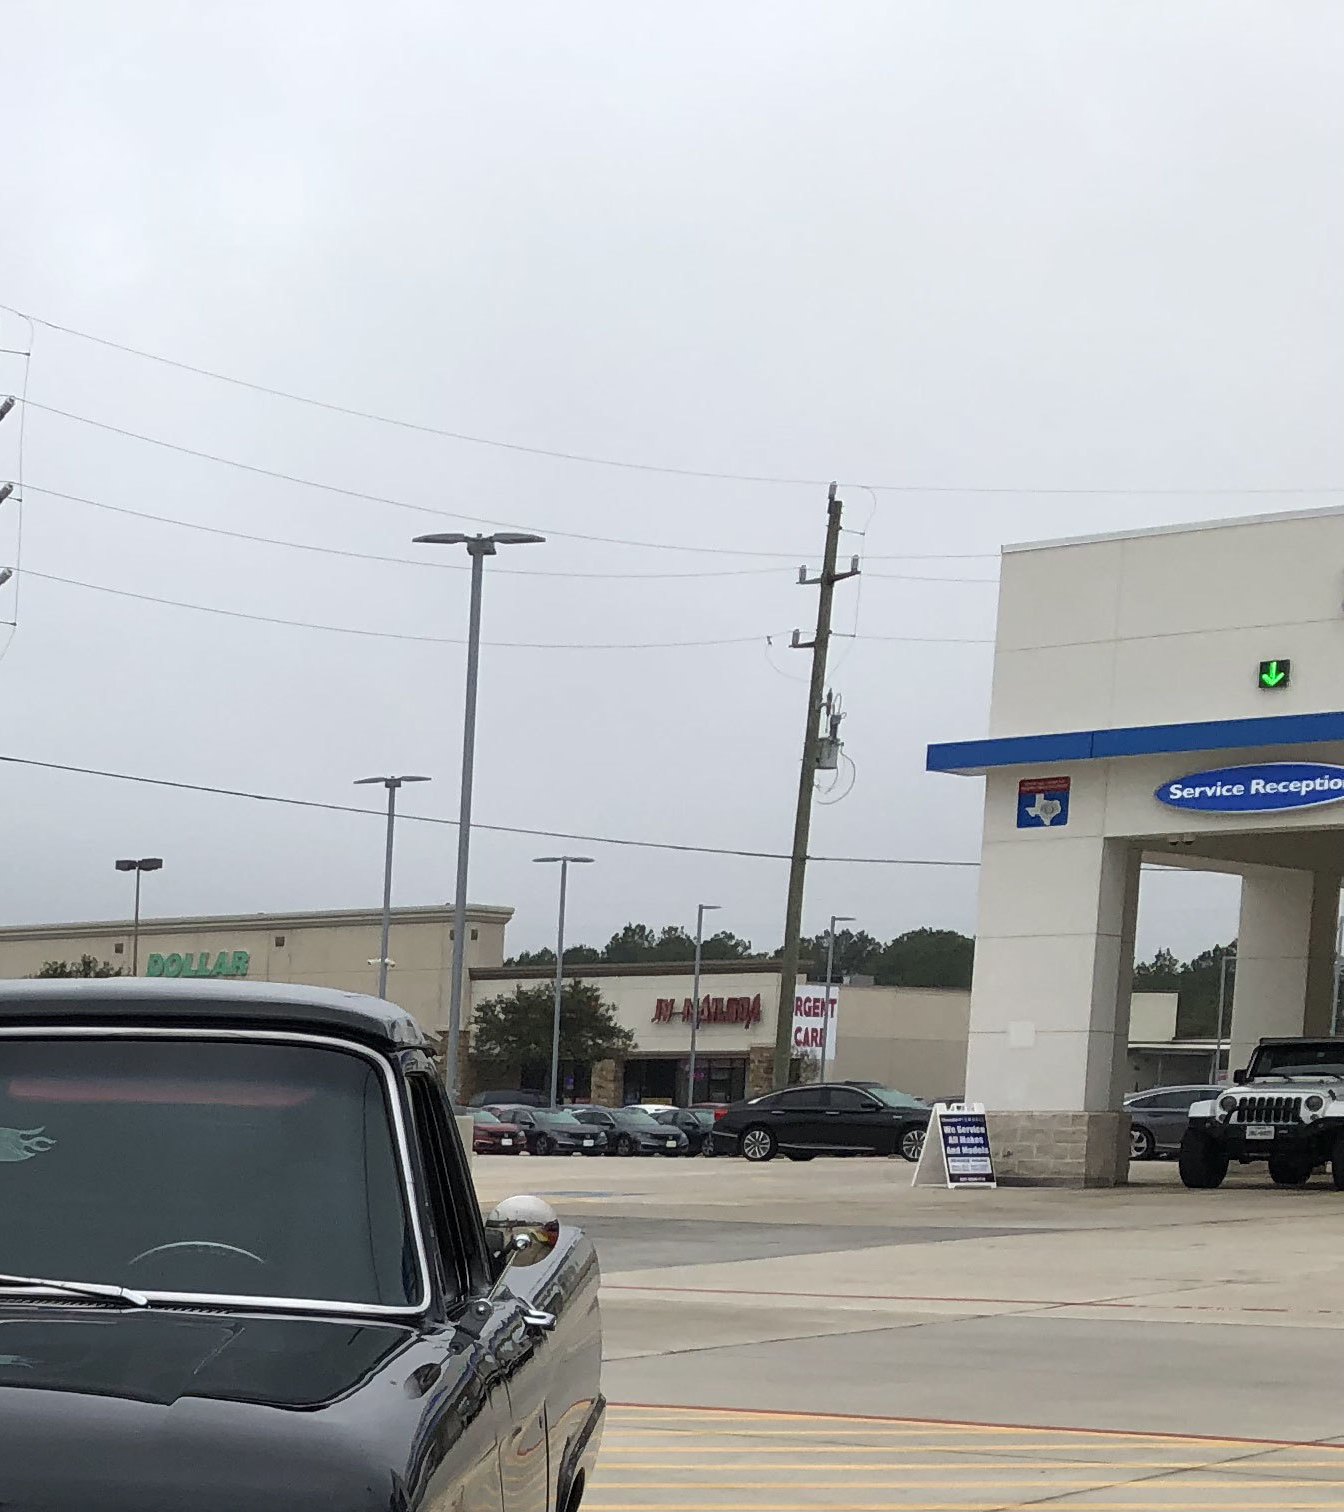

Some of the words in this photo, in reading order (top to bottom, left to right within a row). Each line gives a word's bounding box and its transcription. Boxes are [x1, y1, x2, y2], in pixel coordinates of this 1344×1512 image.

[1169, 781, 1244, 800] Service
[1250, 775, 1344, 796] Receptio
[145, 950, 251, 978] DOLLAR
[794, 996, 838, 1018] RGENT
[956, 1125, 986, 1134] Service
